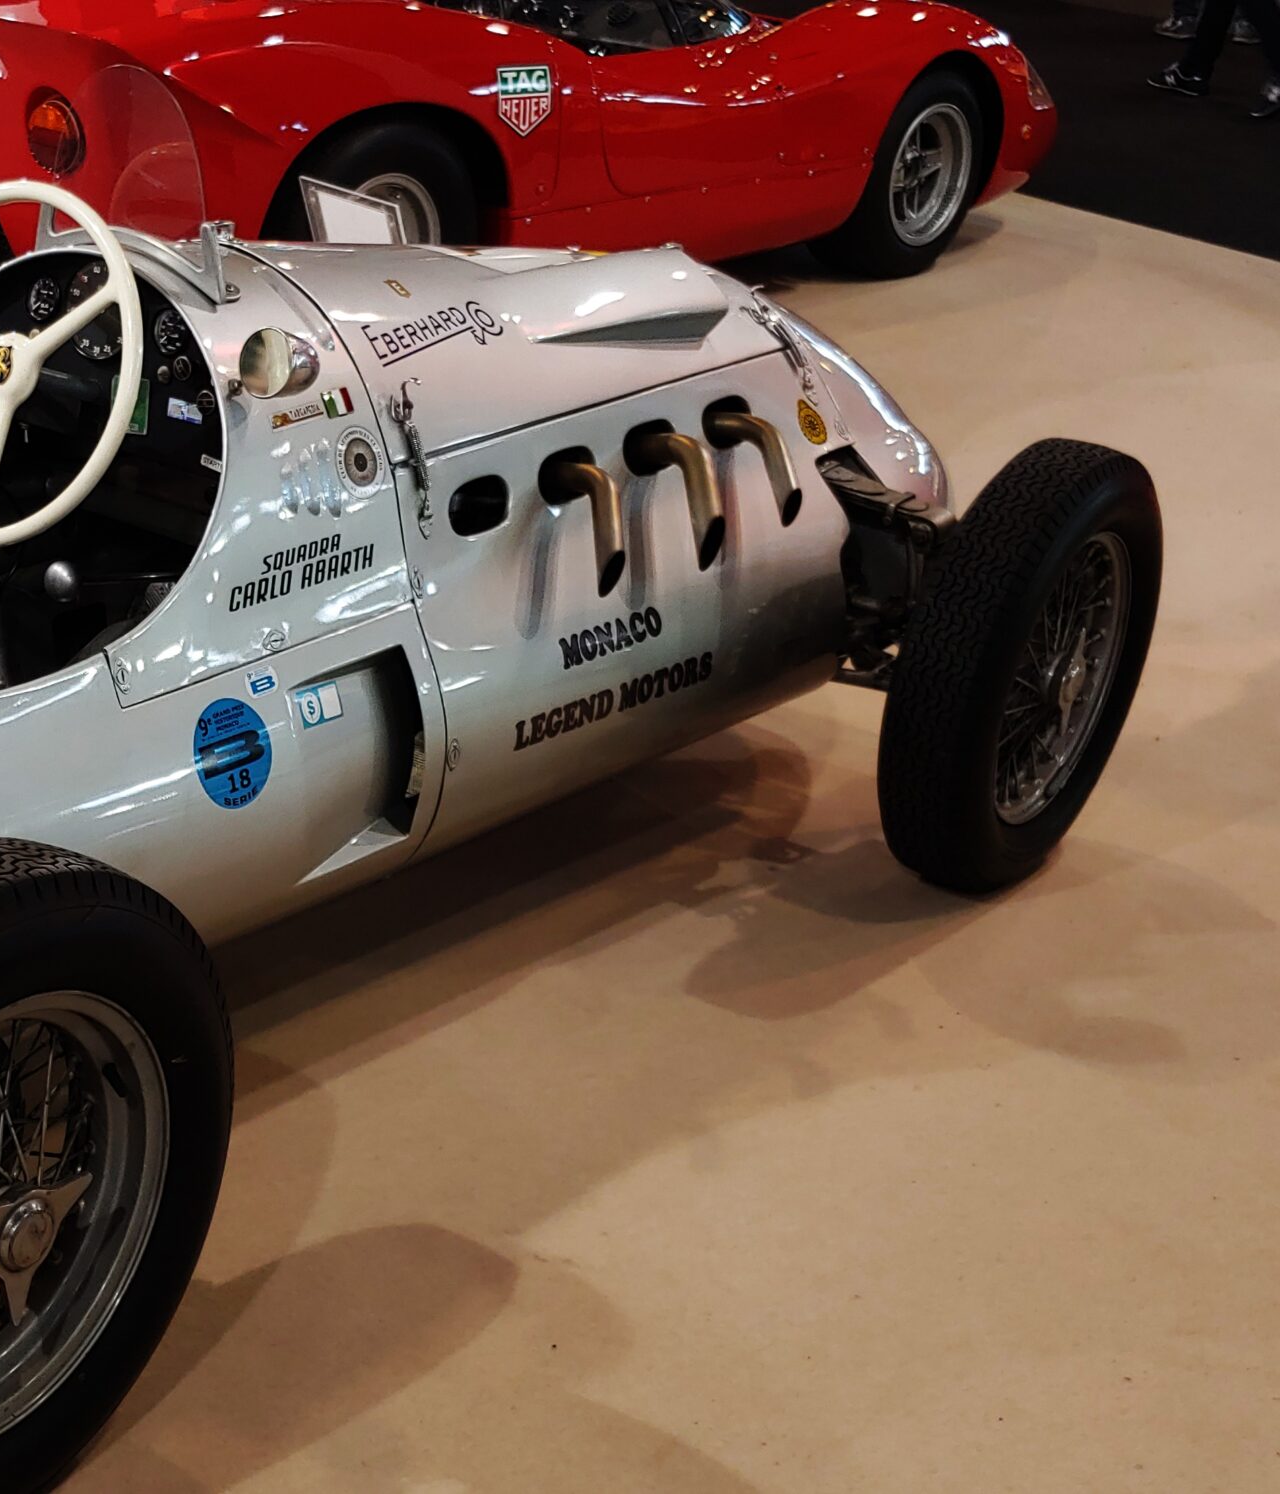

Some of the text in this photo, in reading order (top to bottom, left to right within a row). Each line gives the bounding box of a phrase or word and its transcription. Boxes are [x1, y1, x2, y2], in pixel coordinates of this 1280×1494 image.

[502, 70, 547, 92] TAG
[502, 98, 548, 130] HEUER
[361, 307, 467, 360] EBERHARD
[261, 533, 341, 575] SQUADRA
[229, 543, 374, 612] CARLO ABARTH
[558, 606, 662, 670] MONACO
[250, 675, 275, 695] B
[513, 652, 713, 751] LEGEND MOTORS
[198, 730, 265, 780] B
[224, 785, 258, 807] SERIE
[227, 768, 251, 794] 18
